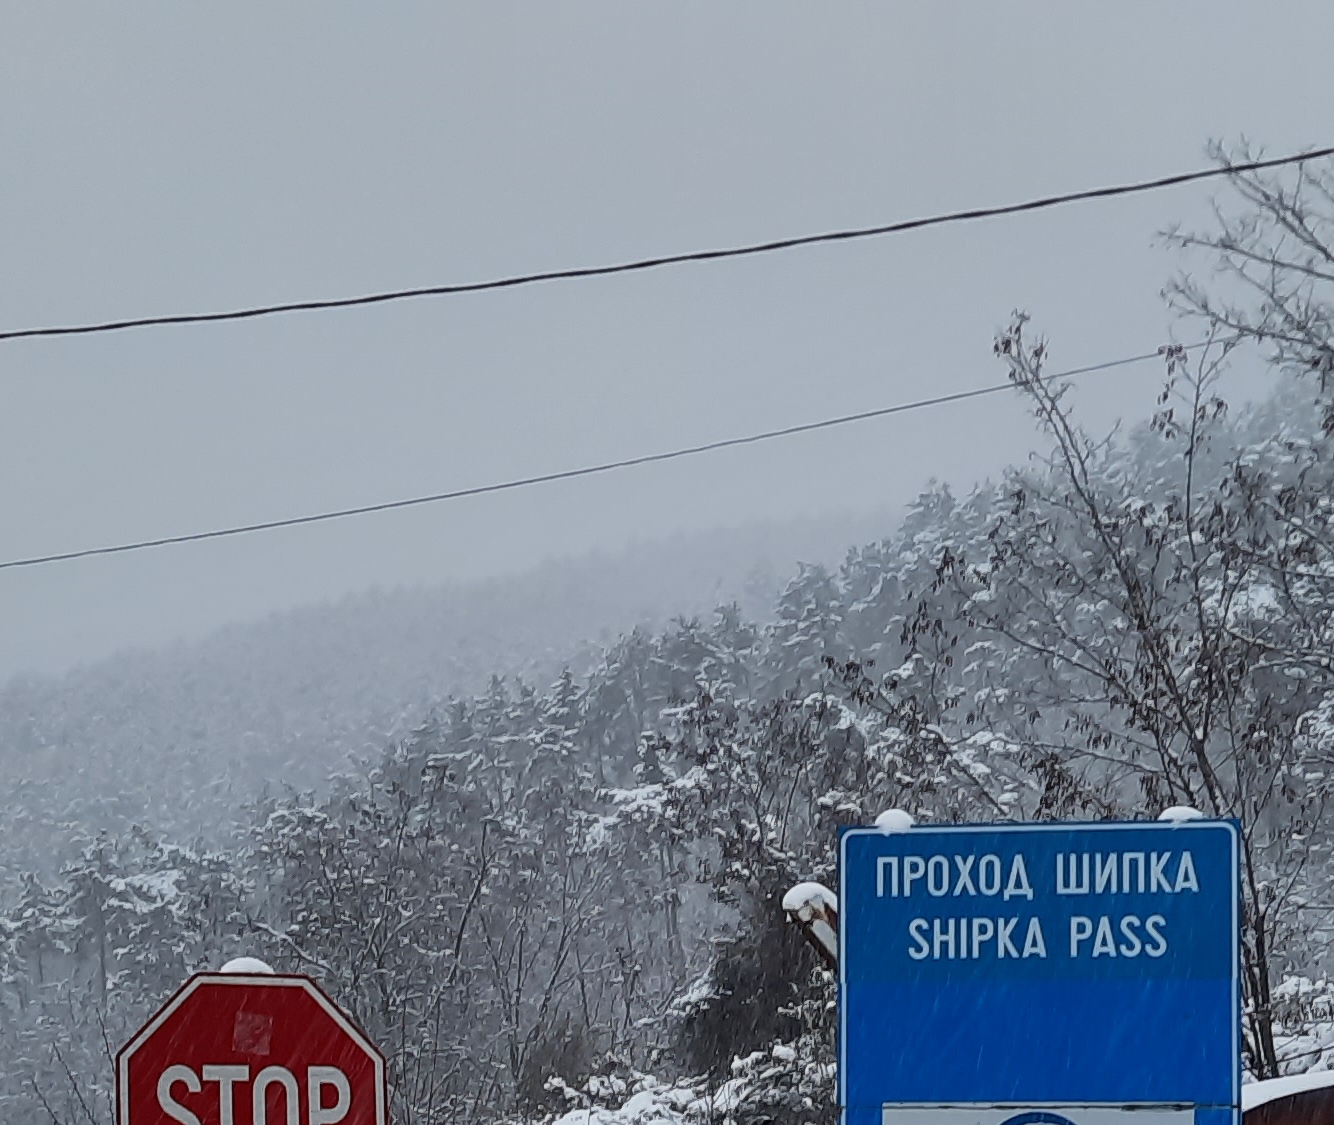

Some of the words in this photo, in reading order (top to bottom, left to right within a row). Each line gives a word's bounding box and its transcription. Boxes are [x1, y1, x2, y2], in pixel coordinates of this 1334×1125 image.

[876, 855, 1034, 900] ПРОХОД
[1056, 852, 1200, 895] ШИПКА
[908, 917, 1047, 960] SHIPKA
[1069, 914, 1167, 958] PASS
